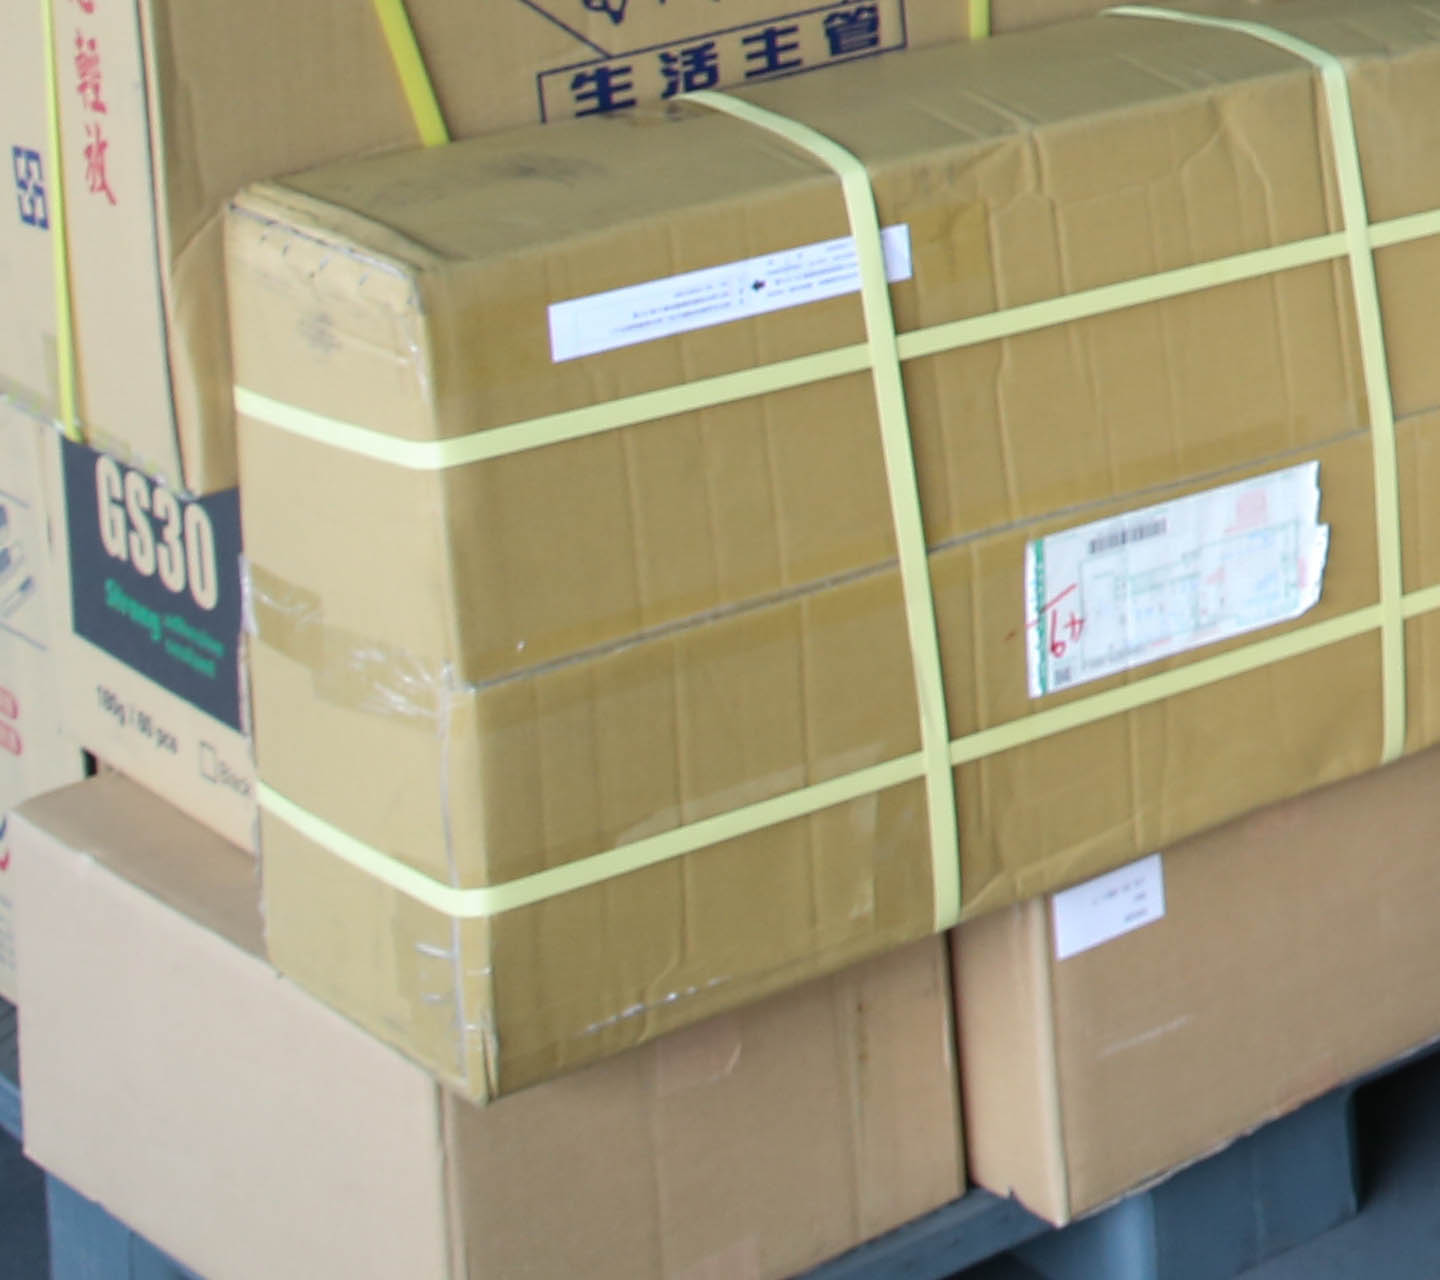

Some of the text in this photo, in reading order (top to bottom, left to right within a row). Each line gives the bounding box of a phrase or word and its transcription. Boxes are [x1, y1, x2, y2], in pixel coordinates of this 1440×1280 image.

[570, 4, 880, 118] 生活主管
[94, 452, 219, 611] GS30
